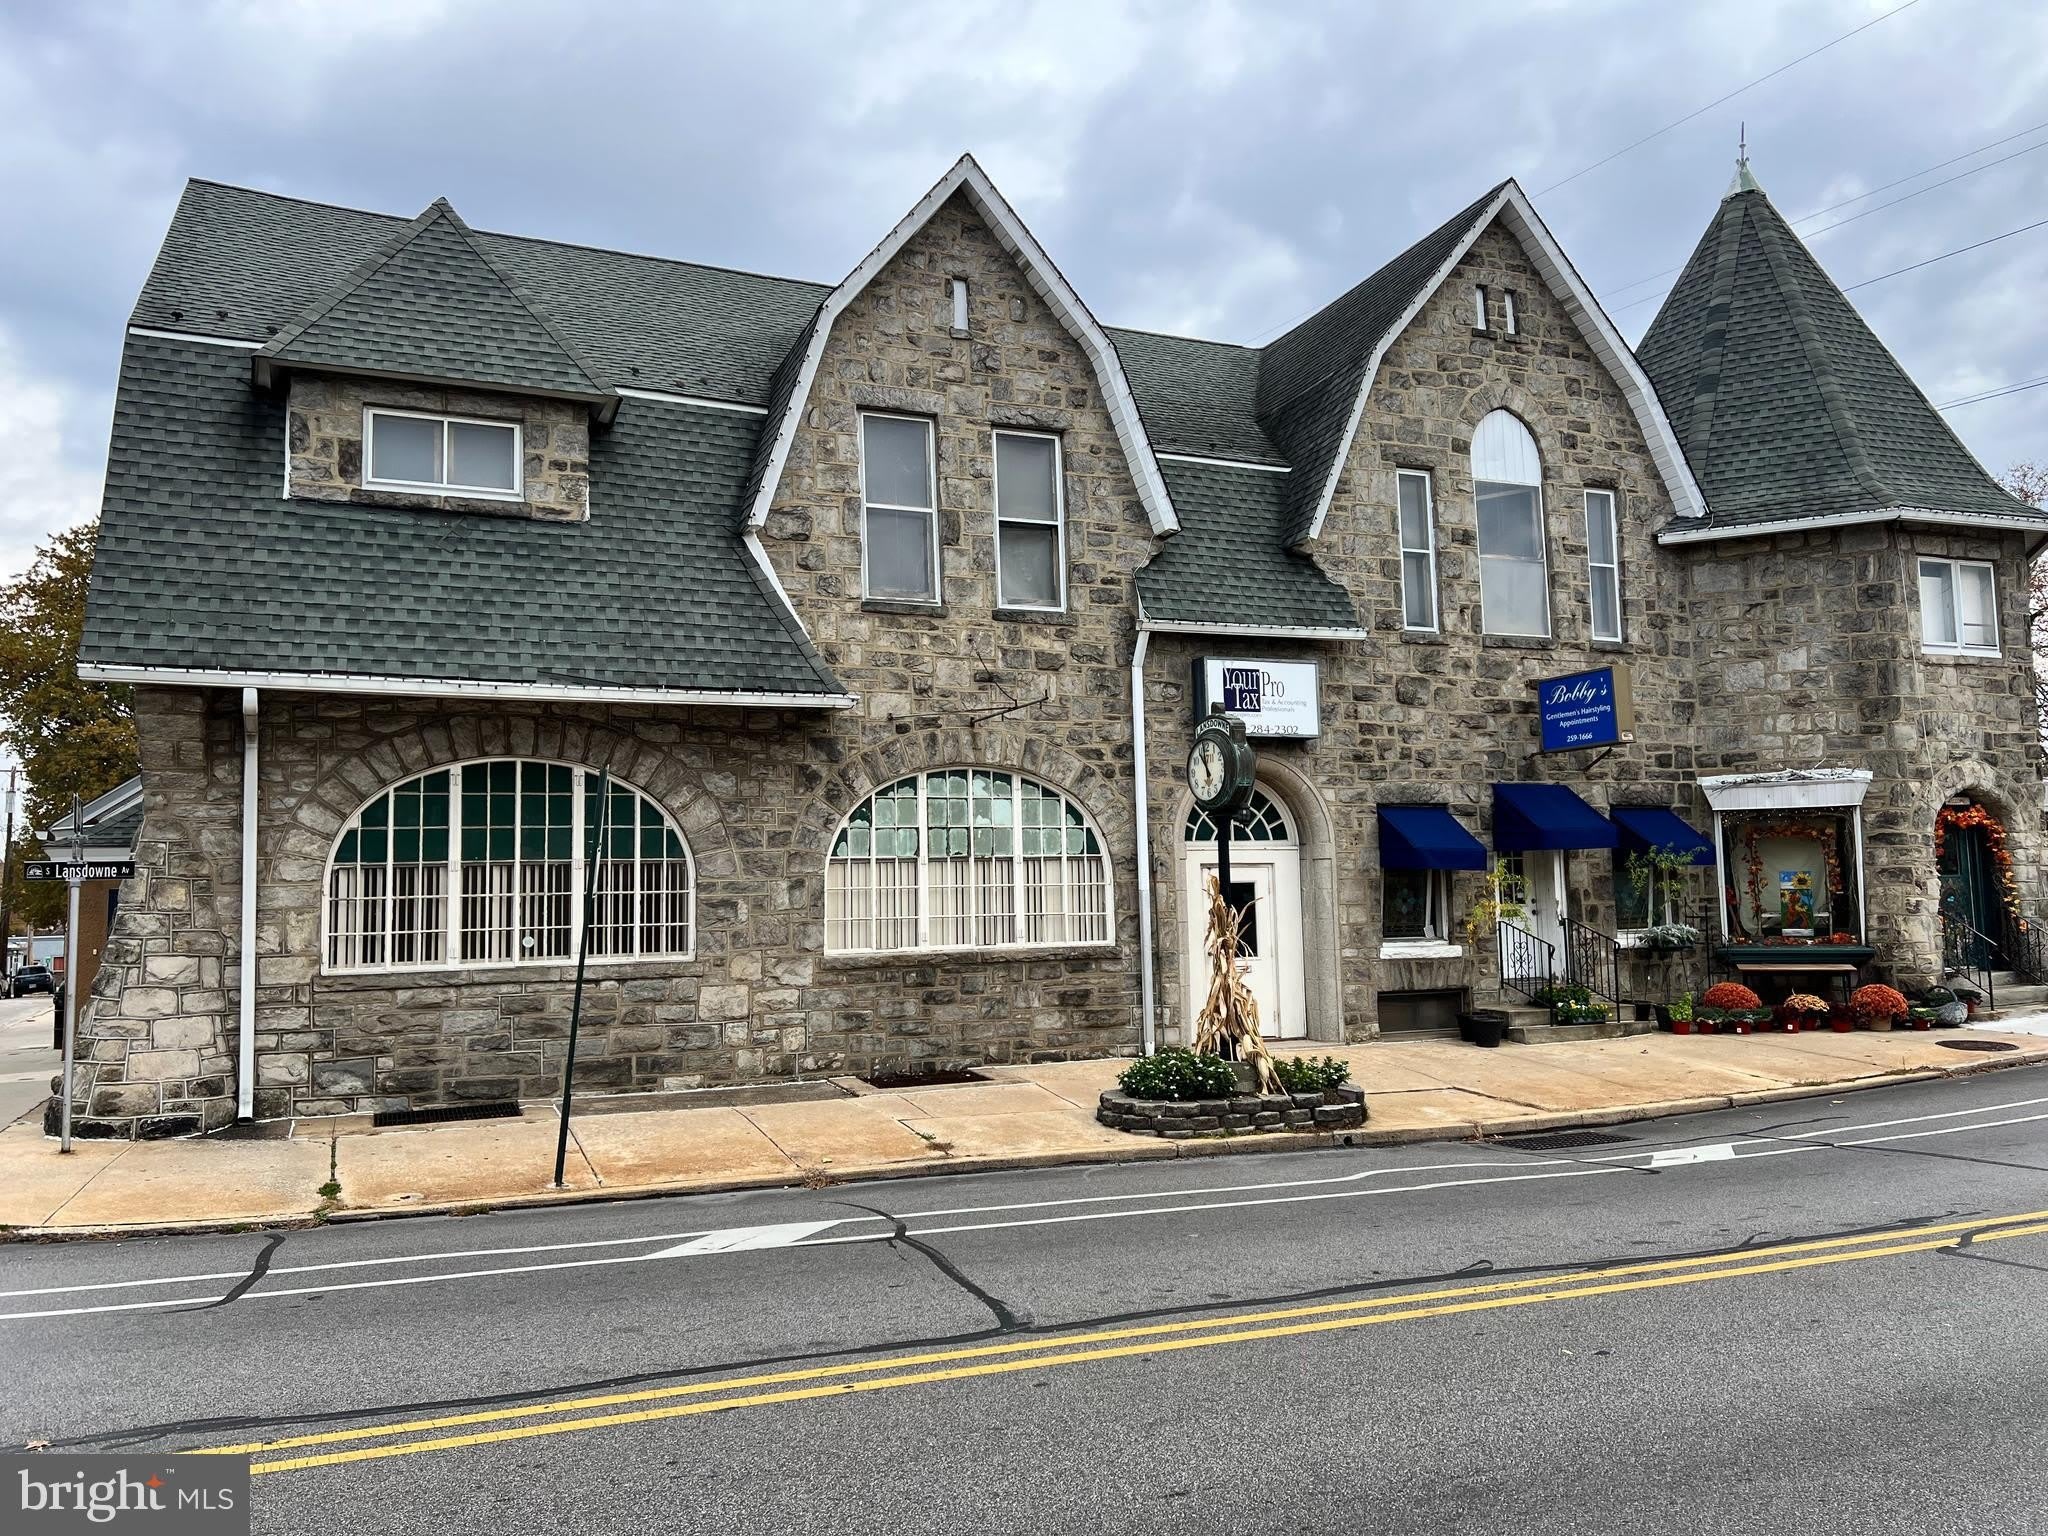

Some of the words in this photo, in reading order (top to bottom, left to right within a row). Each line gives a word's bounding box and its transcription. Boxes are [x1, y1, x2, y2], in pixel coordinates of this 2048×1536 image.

[1222, 661, 1260, 689] Your
[1261, 671, 1285, 697] Pro
[1546, 677, 1607, 705] Bobby's
[1231, 683, 1260, 709] Tax
[1546, 709, 1581, 721] Gentlemen's
[1581, 705, 1611, 716] Hairstyling
[1247, 725, 1298, 735] -284-2302
[1559, 716, 1599, 728] Appointments
[1566, 732, 1593, 743] 259-1666
[45, 866, 51, 875] S
[55, 864, 118, 878] Lansdowne
[121, 866, 130, 874] Av
